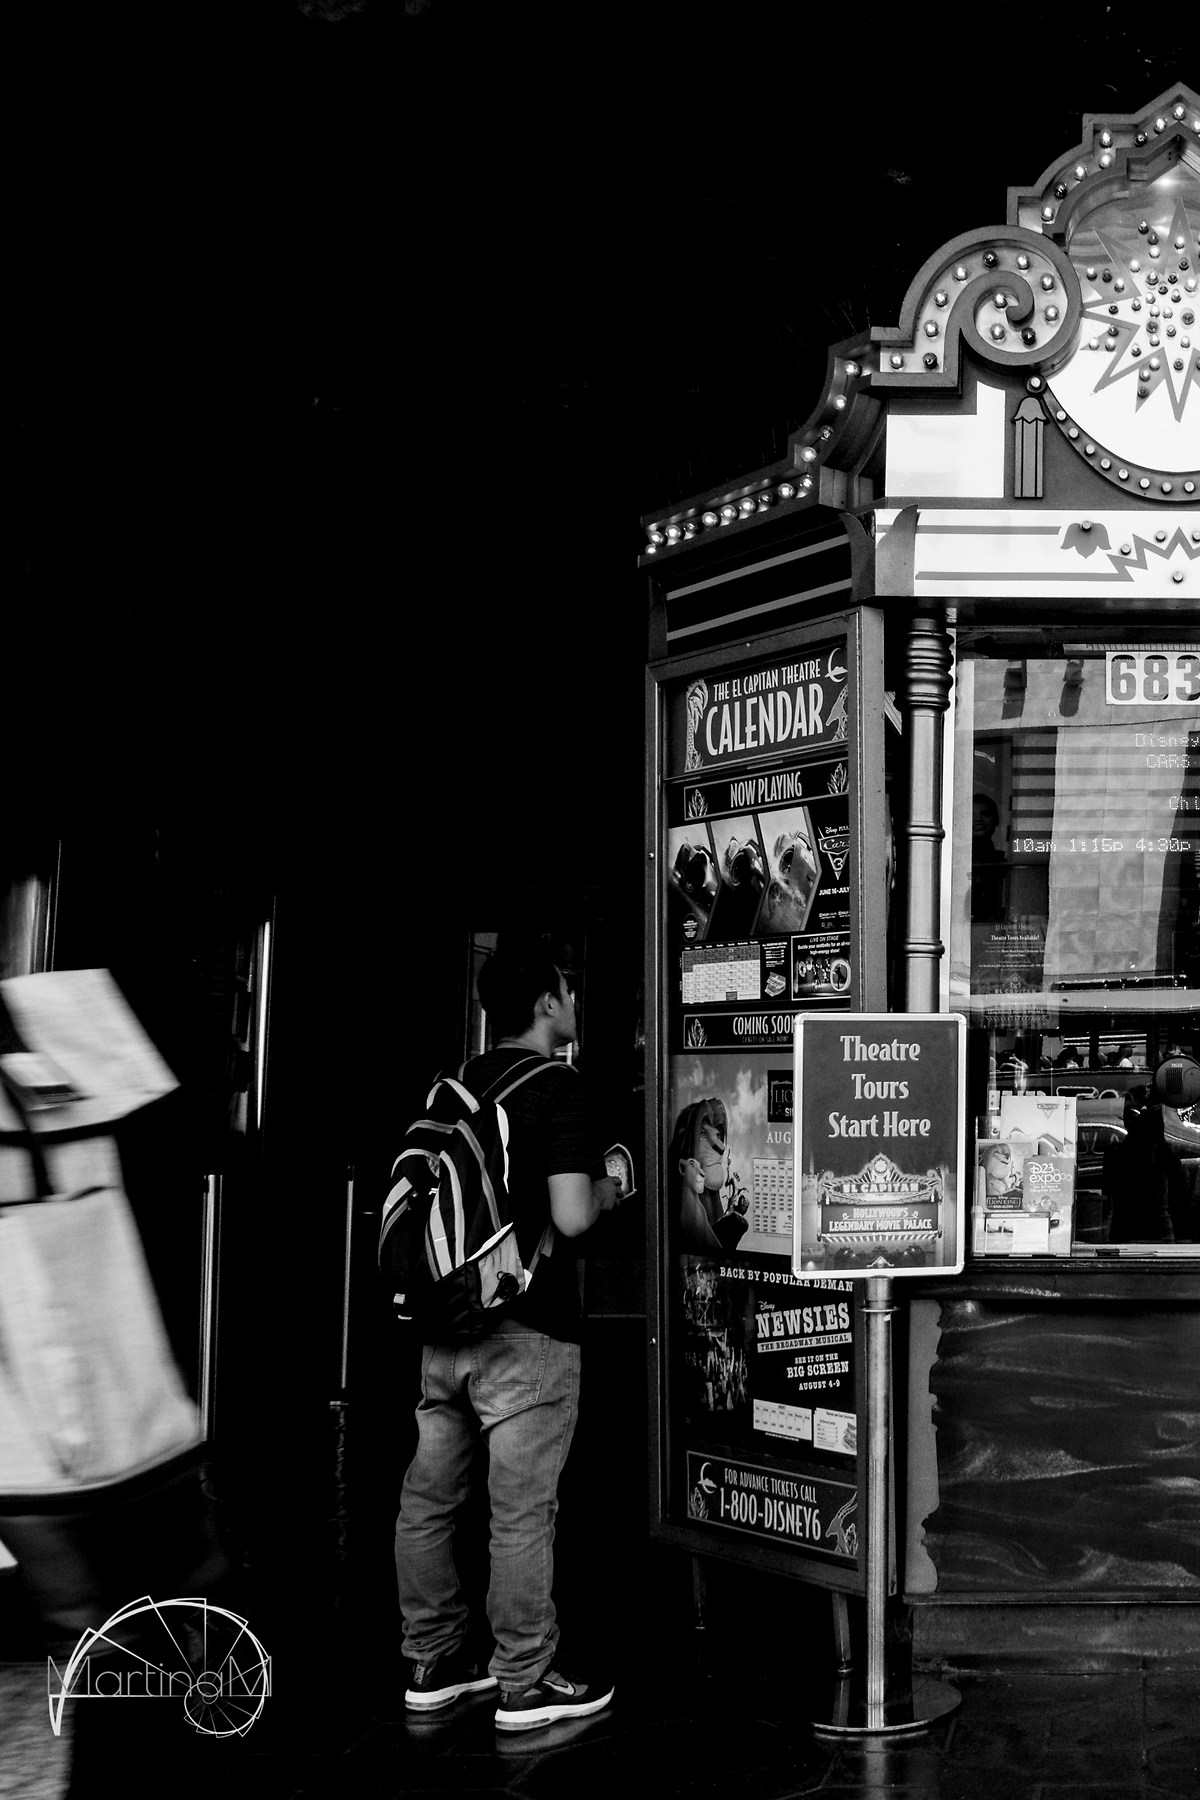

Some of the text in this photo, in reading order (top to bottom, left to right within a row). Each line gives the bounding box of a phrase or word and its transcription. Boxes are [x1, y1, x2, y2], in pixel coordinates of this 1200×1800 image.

[713, 659, 821, 702] THE EL CAPITAN THEATRE
[706, 683, 824, 756] CALENDAR
[1146, 754, 1190, 768] CARS
[730, 771, 803, 808] NOW PLAYING
[1012, 838, 1057, 853] 10am
[1069, 838, 1124, 853] 1:15p
[1134, 838, 1191, 853] 4:30p
[834, 858, 844, 871] 3
[733, 1016, 768, 1035] COMING
[840, 1035, 921, 1062] Theatre
[851, 1073, 910, 1100] Tours
[775, 1089, 793, 1103] LIO
[828, 1111, 932, 1138] Start Here
[766, 1131, 792, 1144] AUG
[1027, 1161, 1054, 1174] D23
[843, 1183, 919, 1193] EL CAPITAN
[1029, 1174, 1061, 1186] expo
[853, 1207, 909, 1219] HOLLYWOOD'S
[829, 1218, 933, 1232] LEGENDARY MOVIE PALACE
[720, 1266, 854, 1292] BACK BY POPULAR DEMAN
[755, 1302, 850, 1339] NEWSIES
[760, 1335, 849, 1351] THE BROADWAY MUSICAL
[794, 1353, 838, 1364] SEE IT ON THE
[787, 1361, 849, 1378] BIG SCREEN
[798, 1379, 841, 1391] AUGUST 4-9
[724, 1468, 817, 1504] FOR ADVANCE TICKETS CALL
[720, 1487, 821, 1540] 1-800-DISNEY6
